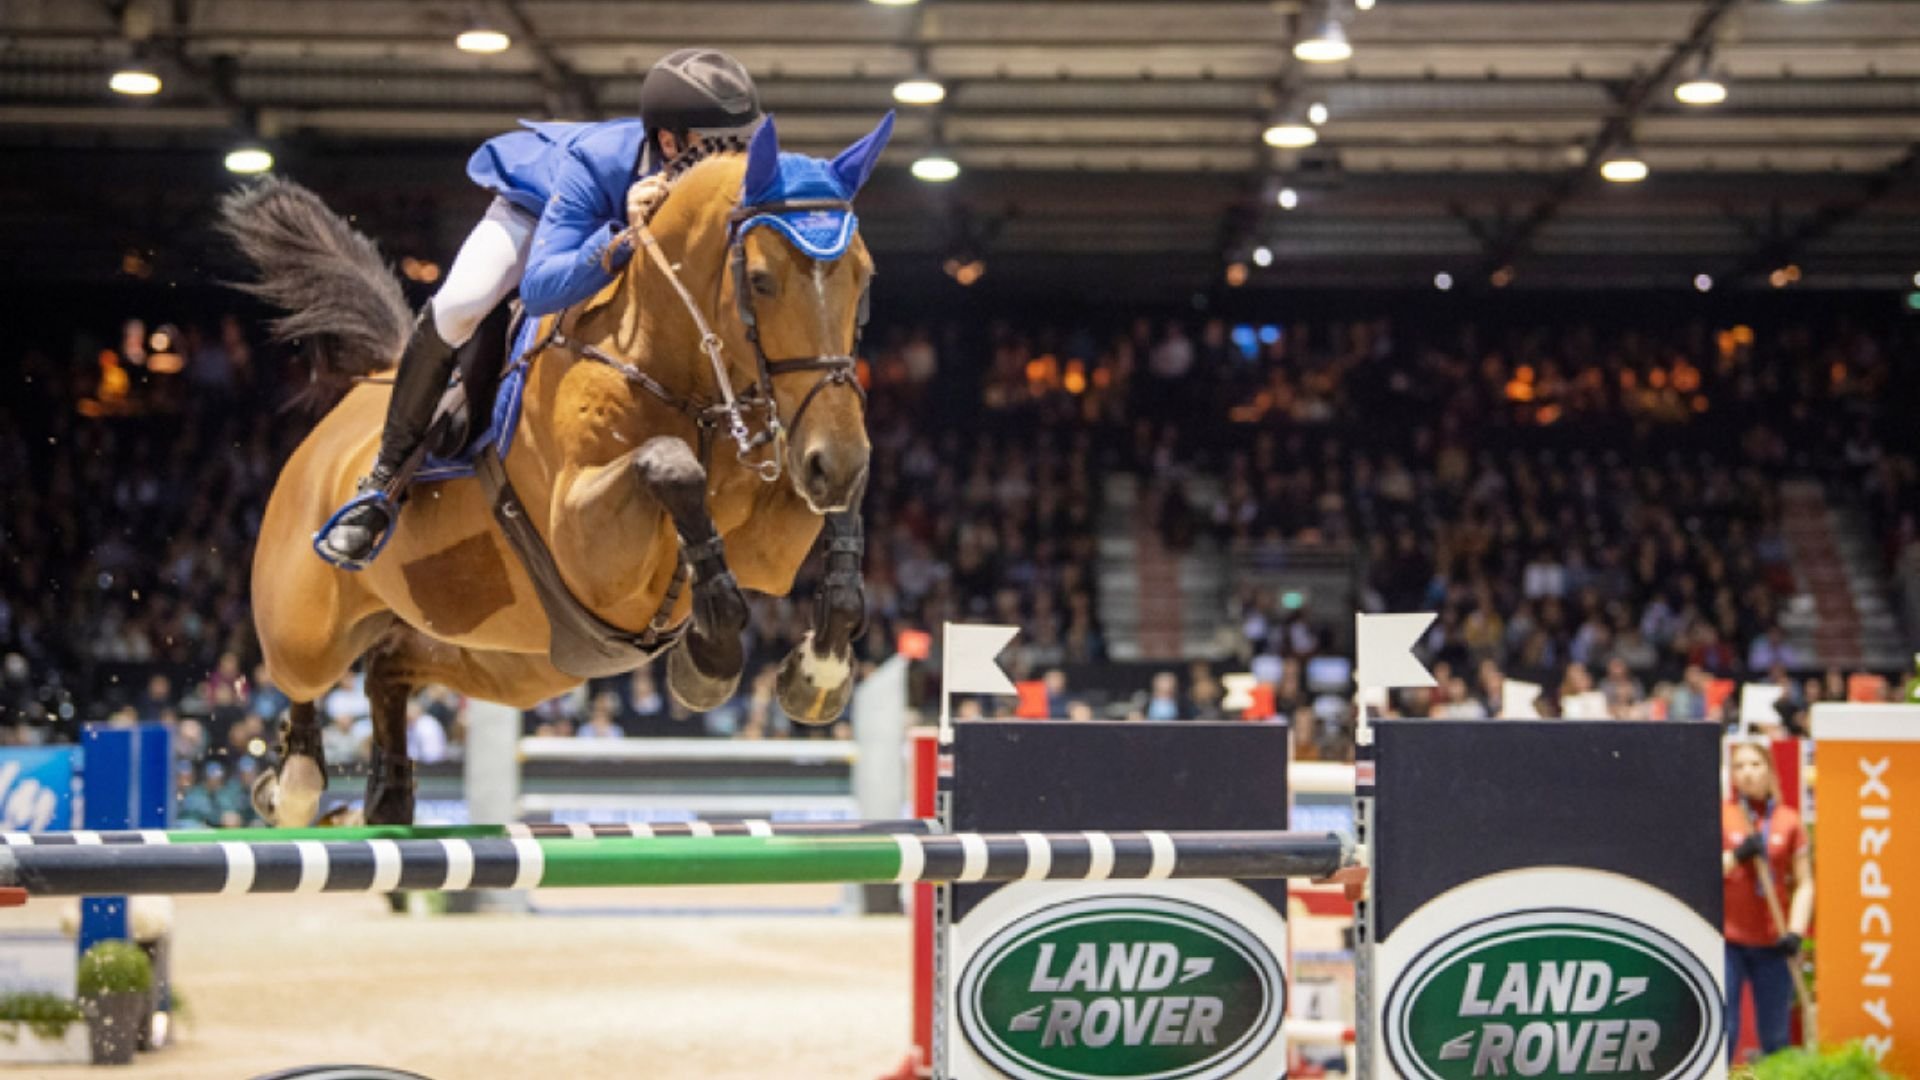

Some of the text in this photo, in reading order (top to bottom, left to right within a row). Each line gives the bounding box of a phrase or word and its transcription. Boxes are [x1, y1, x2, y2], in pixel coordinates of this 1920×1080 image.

[1859, 756, 1893, 1065] RANDPRIX
[1028, 942, 1180, 992] LAND
[1458, 960, 1613, 1017] LAND
[1040, 996, 1224, 1048] ROVER
[1472, 1019, 1661, 1077] ROVER
